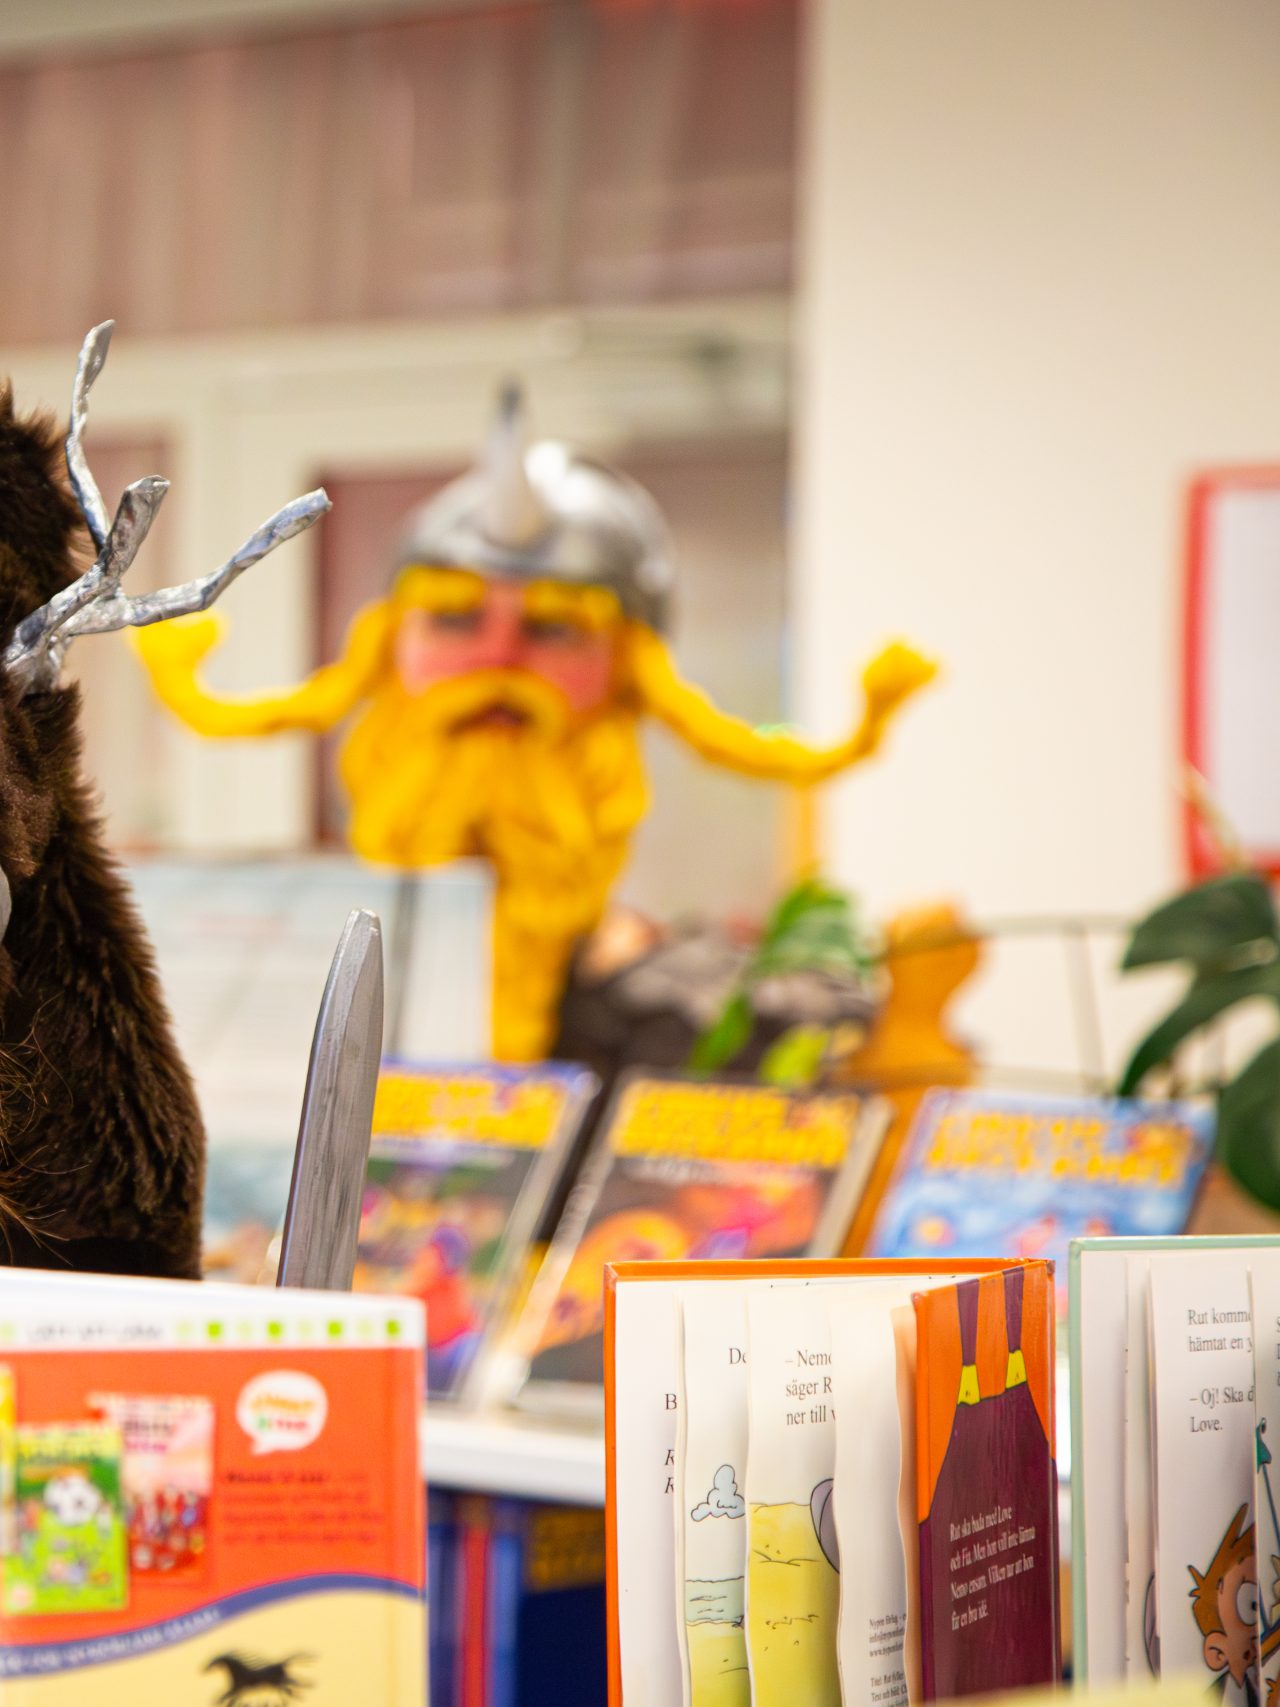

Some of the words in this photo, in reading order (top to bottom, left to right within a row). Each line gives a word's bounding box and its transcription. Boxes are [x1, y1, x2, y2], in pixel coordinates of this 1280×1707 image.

[1187, 1309, 1208, 1326] Rut
[1188, 1336, 1227, 1352] hämtat
[1231, 1337, 1244, 1350] en
[785, 1378, 819, 1401] säger
[1201, 1387, 1219, 1410] Oj!
[1223, 1386, 1244, 1404] Ska
[664, 1393, 678, 1411] B
[786, 1410, 806, 1426] ner
[810, 1404, 827, 1424] till
[1190, 1416, 1223, 1433] Love.
[950, 1522, 961, 1542] Rut
[961, 1517, 972, 1538] ska
[985, 1507, 998, 1529] med
[997, 1504, 1013, 1523] Love
[950, 1550, 961, 1572] och
[973, 1542, 986, 1562] Men
[951, 1581, 969, 1601] Nemo
